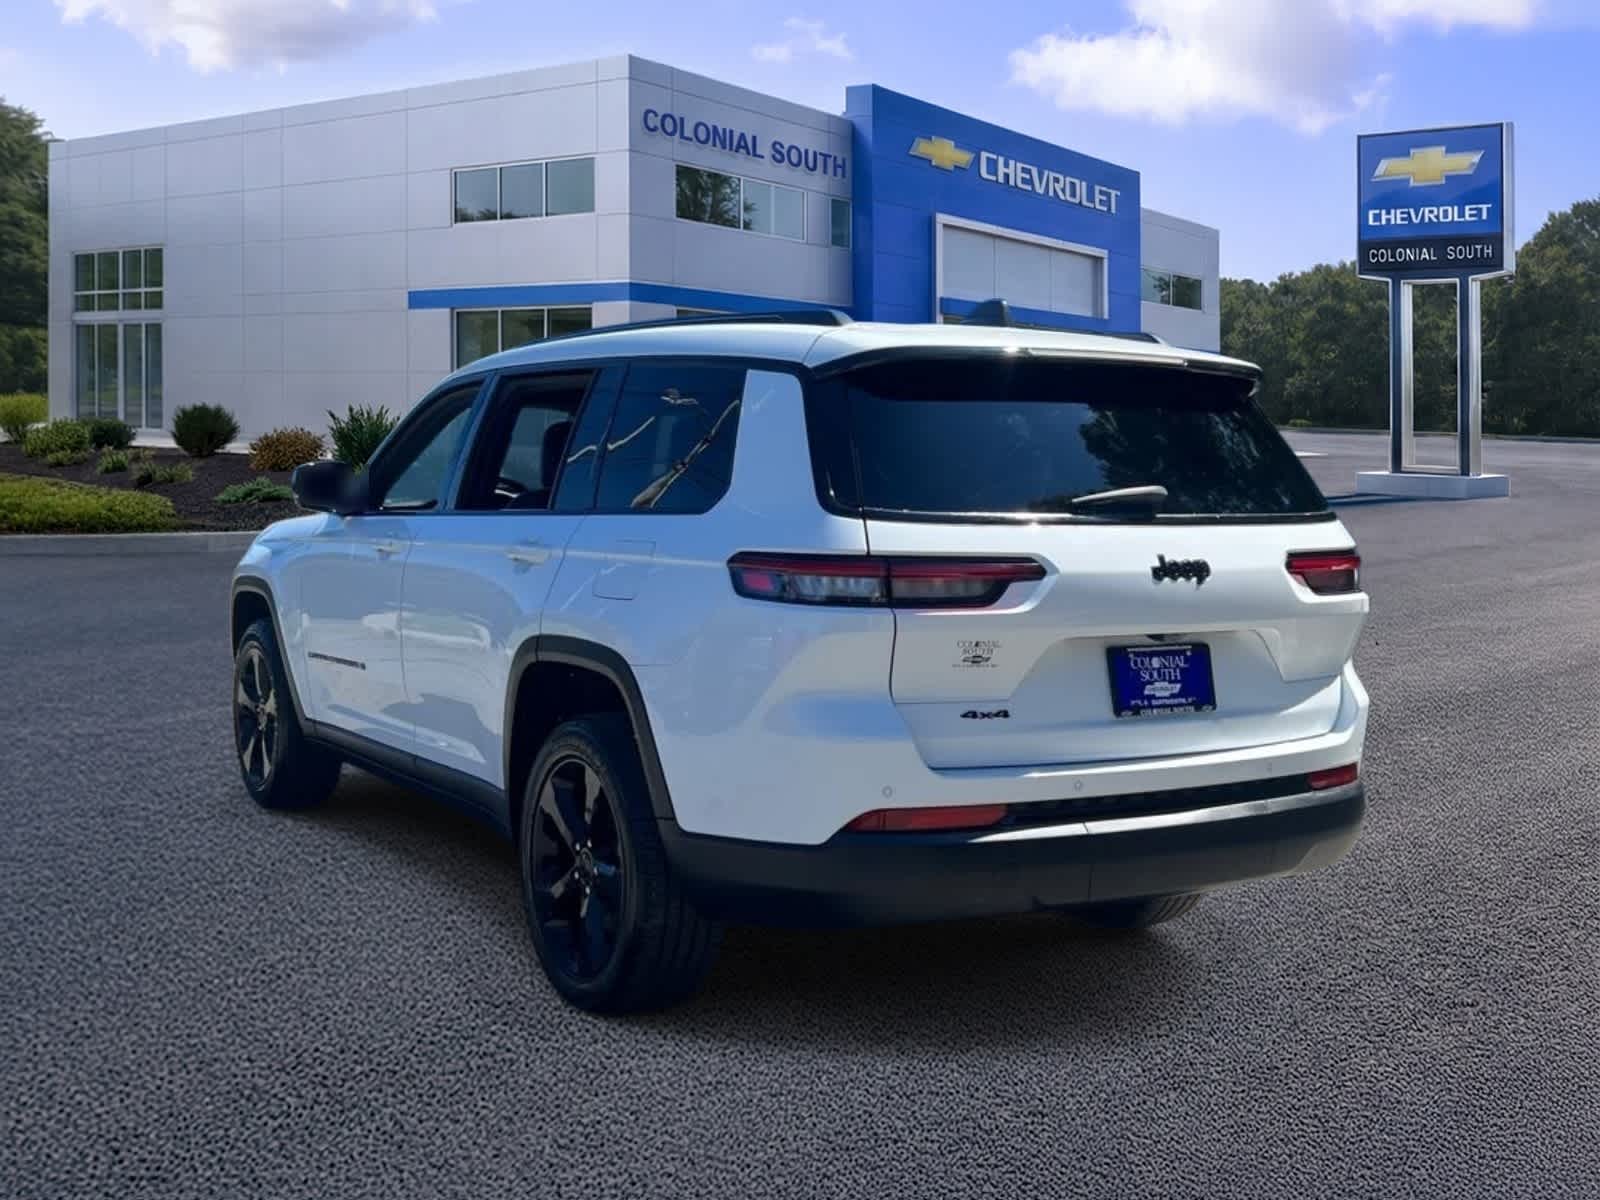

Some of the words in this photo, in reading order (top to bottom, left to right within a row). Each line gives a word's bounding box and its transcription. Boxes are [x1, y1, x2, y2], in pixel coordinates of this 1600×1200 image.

[643, 108, 765, 159] COLONIAL
[771, 140, 847, 178] SOUTH
[979, 151, 1121, 214] CHEVROLET
[1368, 203, 1493, 226] CHEVROLET
[1369, 247, 1438, 263] COLONIAL
[1447, 244, 1492, 260] SOUTH
[1150, 553, 1211, 585] Jeep
[1130, 655, 1189, 670] COLONIAL
[1140, 668, 1181, 682] SOUTH
[959, 709, 1010, 719] 4x4
